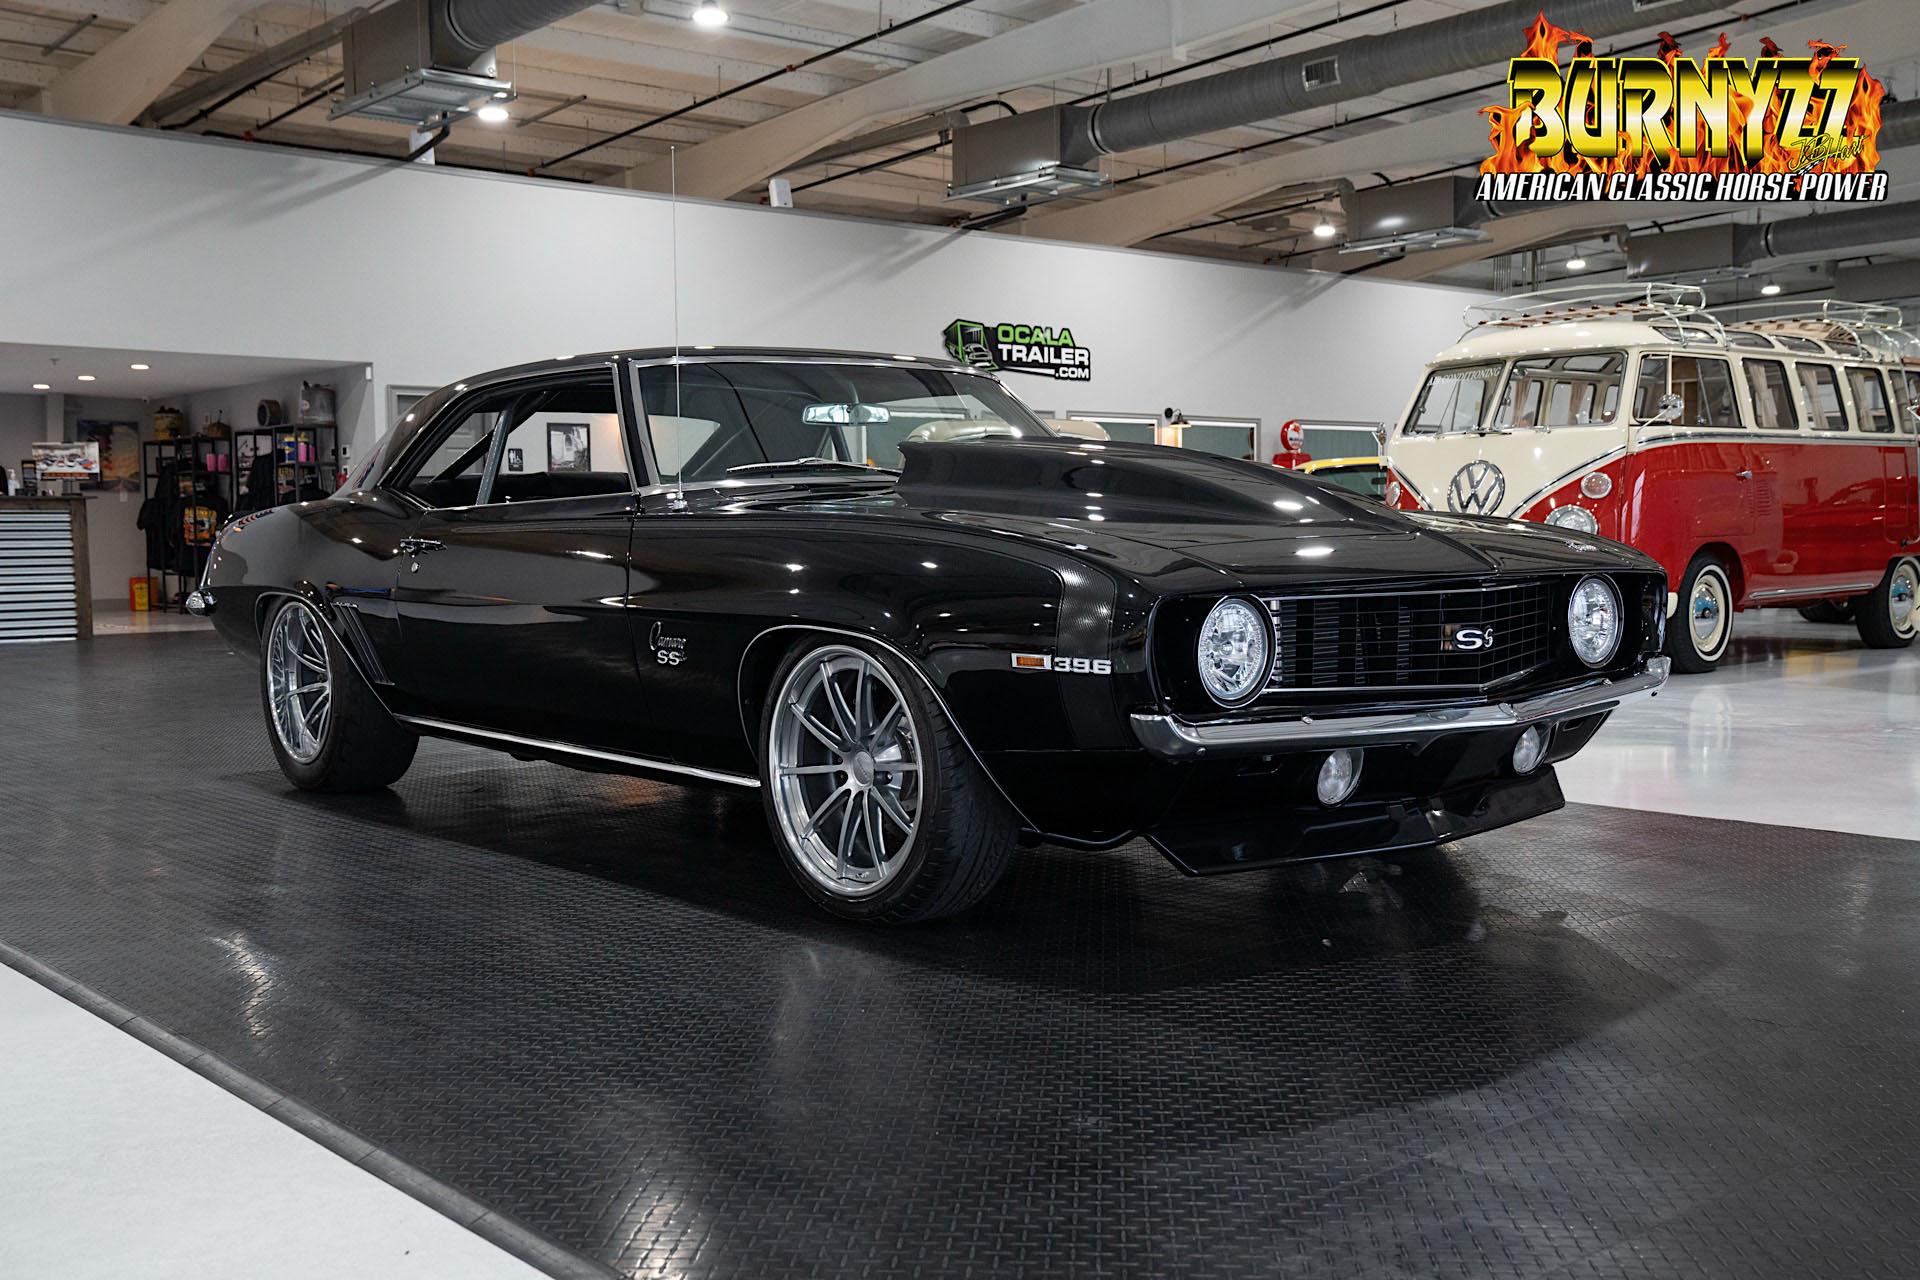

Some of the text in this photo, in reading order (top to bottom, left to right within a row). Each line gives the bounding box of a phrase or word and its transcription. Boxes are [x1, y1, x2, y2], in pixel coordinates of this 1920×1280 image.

[997, 324, 1074, 346] OCALA
[997, 343, 1089, 366] TRAILER
[1055, 367, 1089, 379] .COM
[657, 650, 680, 666] SS
[1053, 656, 1112, 675] 396
